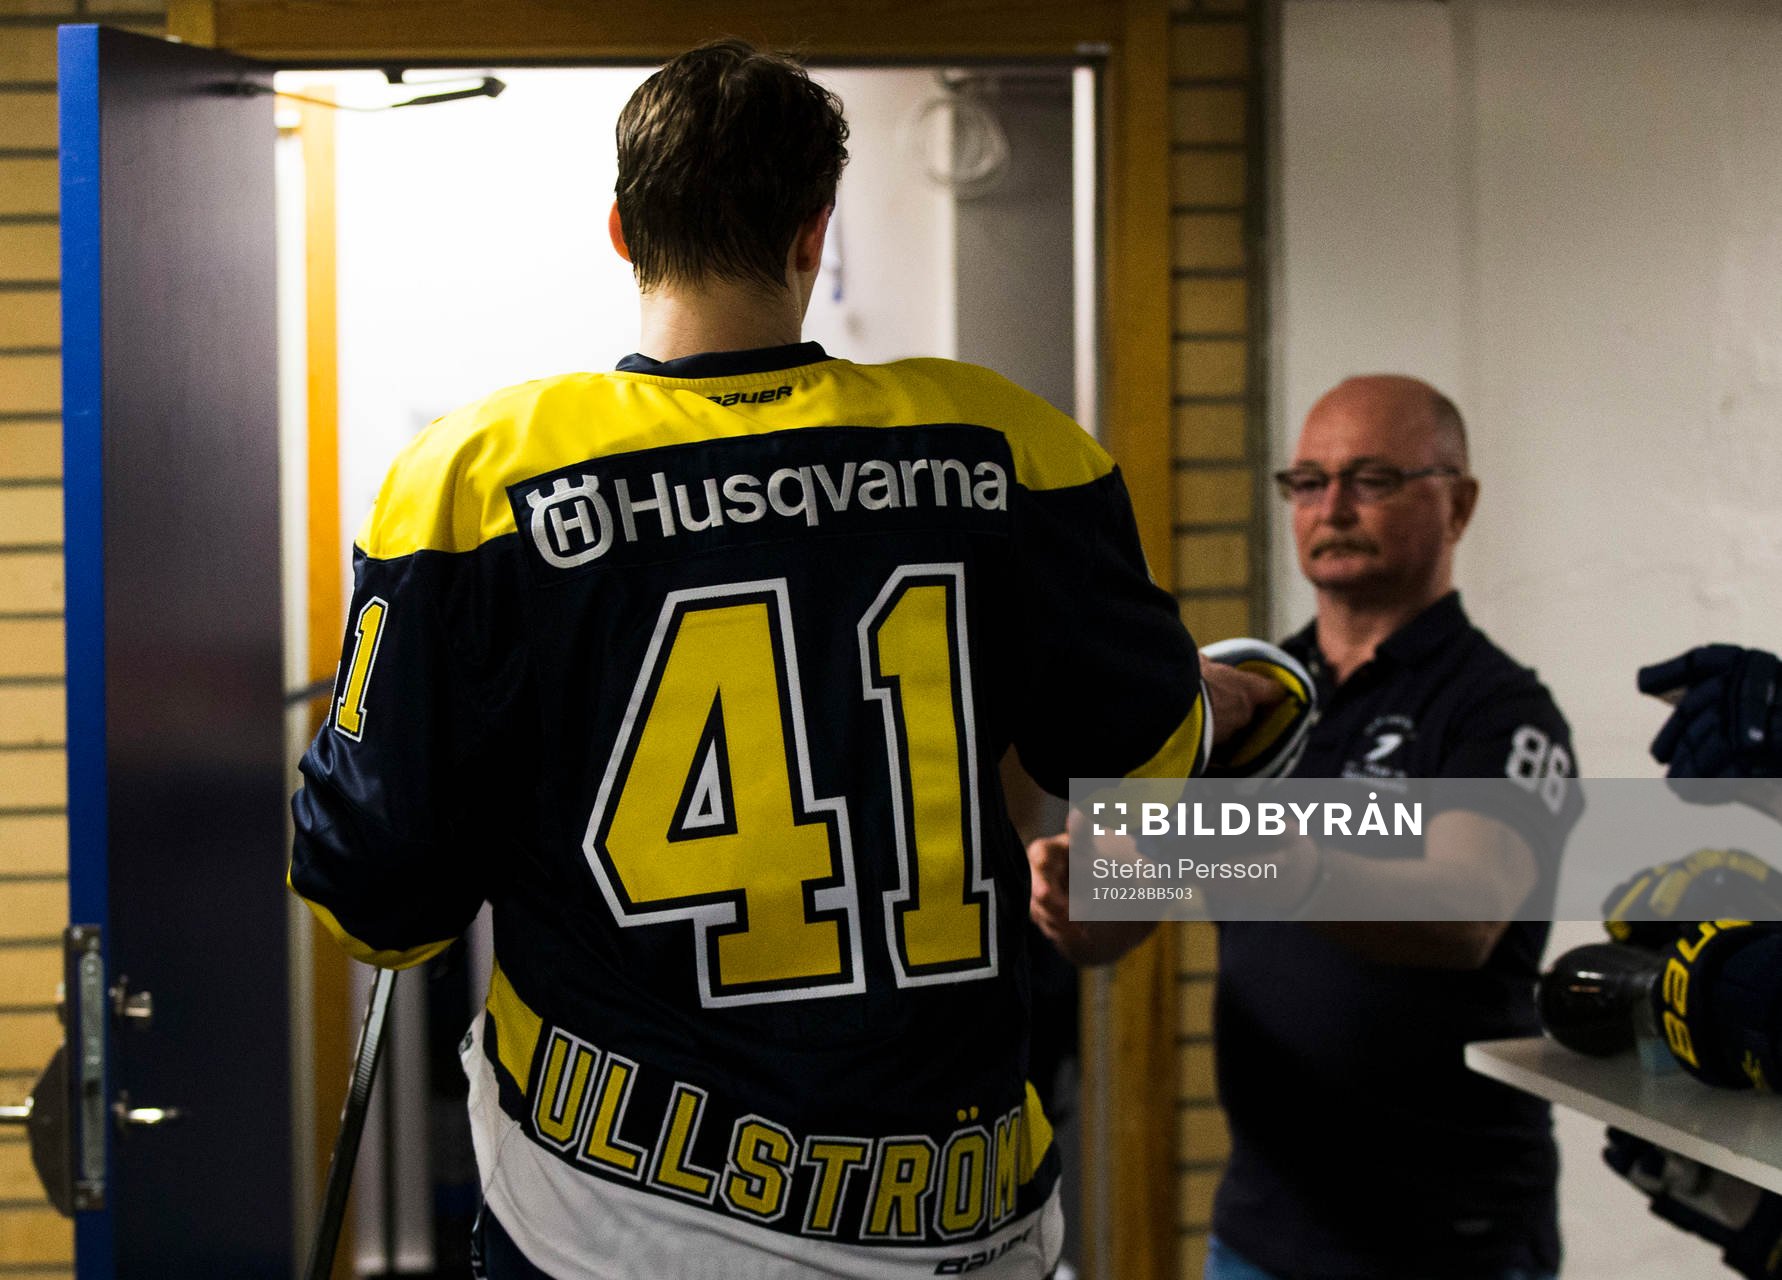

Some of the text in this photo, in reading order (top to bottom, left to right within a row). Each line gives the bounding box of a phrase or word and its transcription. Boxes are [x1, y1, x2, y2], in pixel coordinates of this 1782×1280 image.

[614, 458, 1008, 543] Husqvarna
[327, 595, 389, 742] 1
[582, 562, 999, 1009] 41
[1504, 726, 1571, 815] 86
[532, 1026, 1022, 1241] ULLSTRÖM
